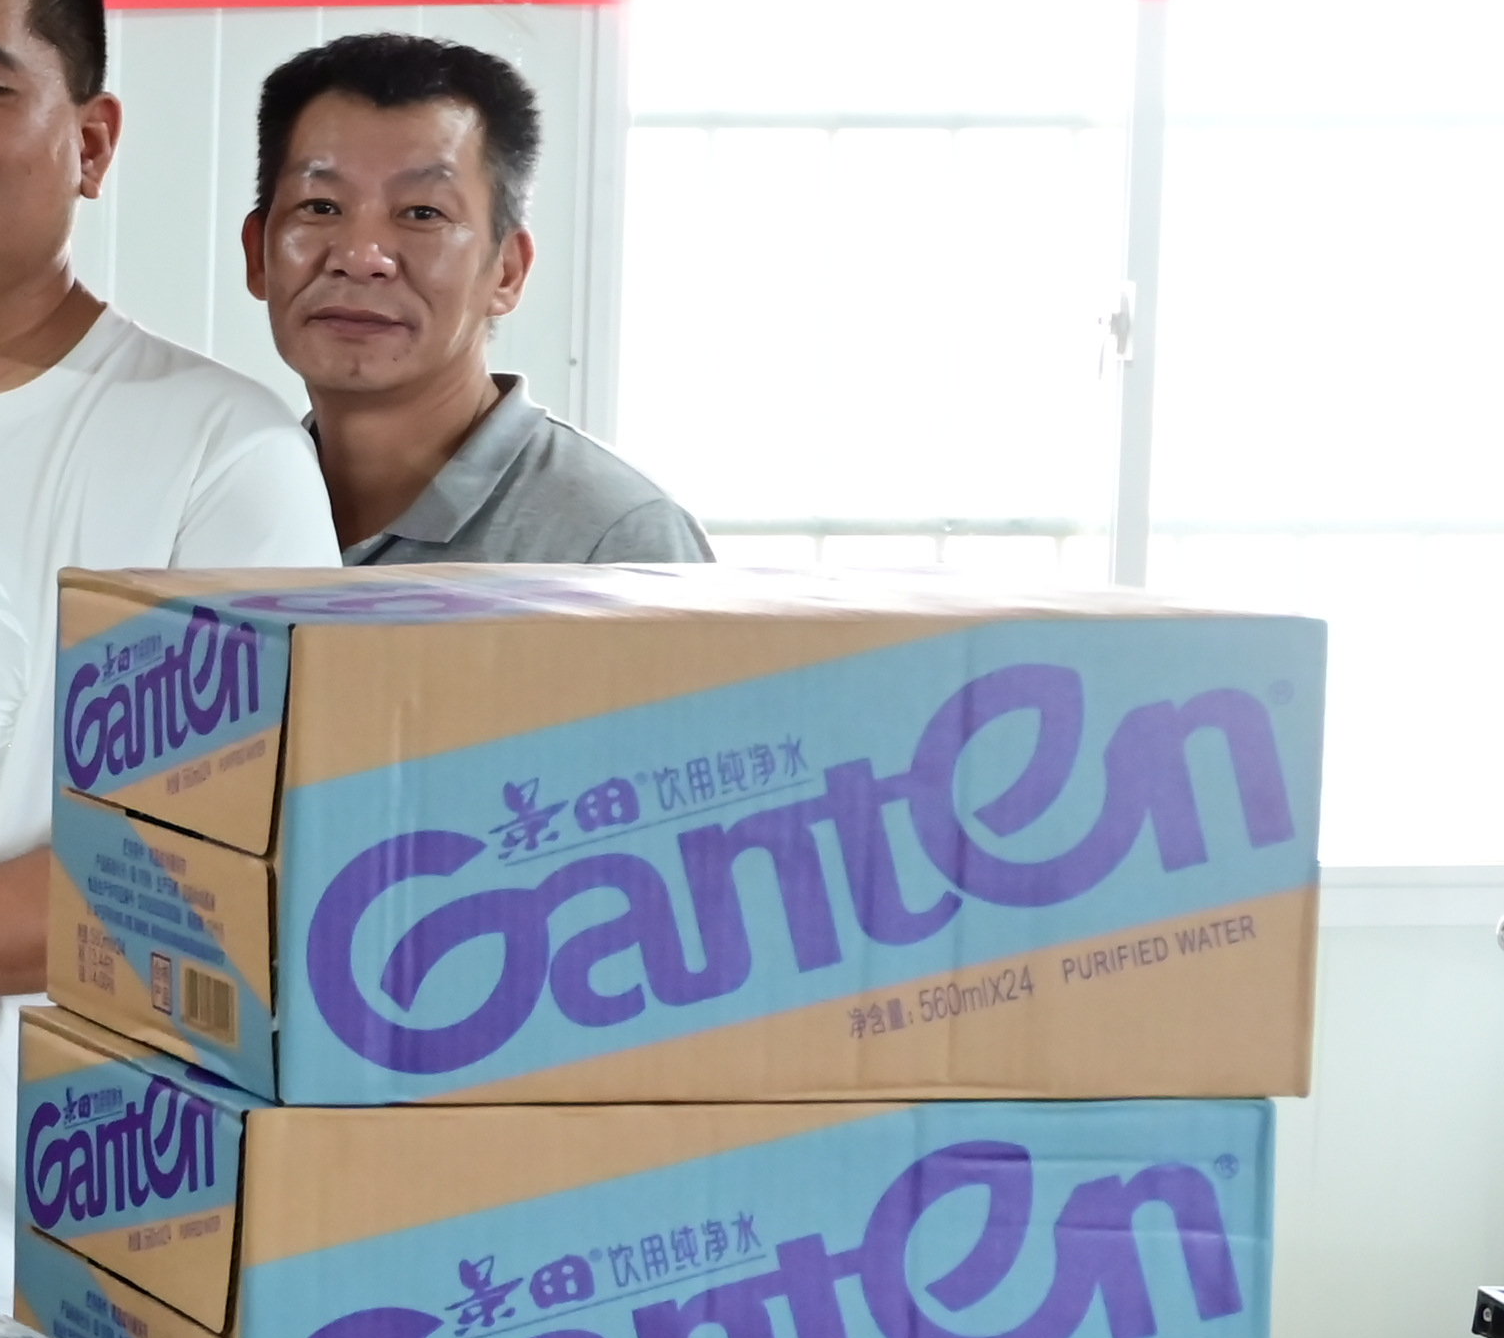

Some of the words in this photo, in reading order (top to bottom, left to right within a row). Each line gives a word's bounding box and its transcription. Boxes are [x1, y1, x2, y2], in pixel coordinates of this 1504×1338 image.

[64, 605, 259, 790] Ganten
[307, 661, 1295, 1074] Ganten
[1061, 934, 1167, 985] PURIFIED
[1175, 913, 1256, 955] WATER
[25, 1076, 216, 1229] Ganten
